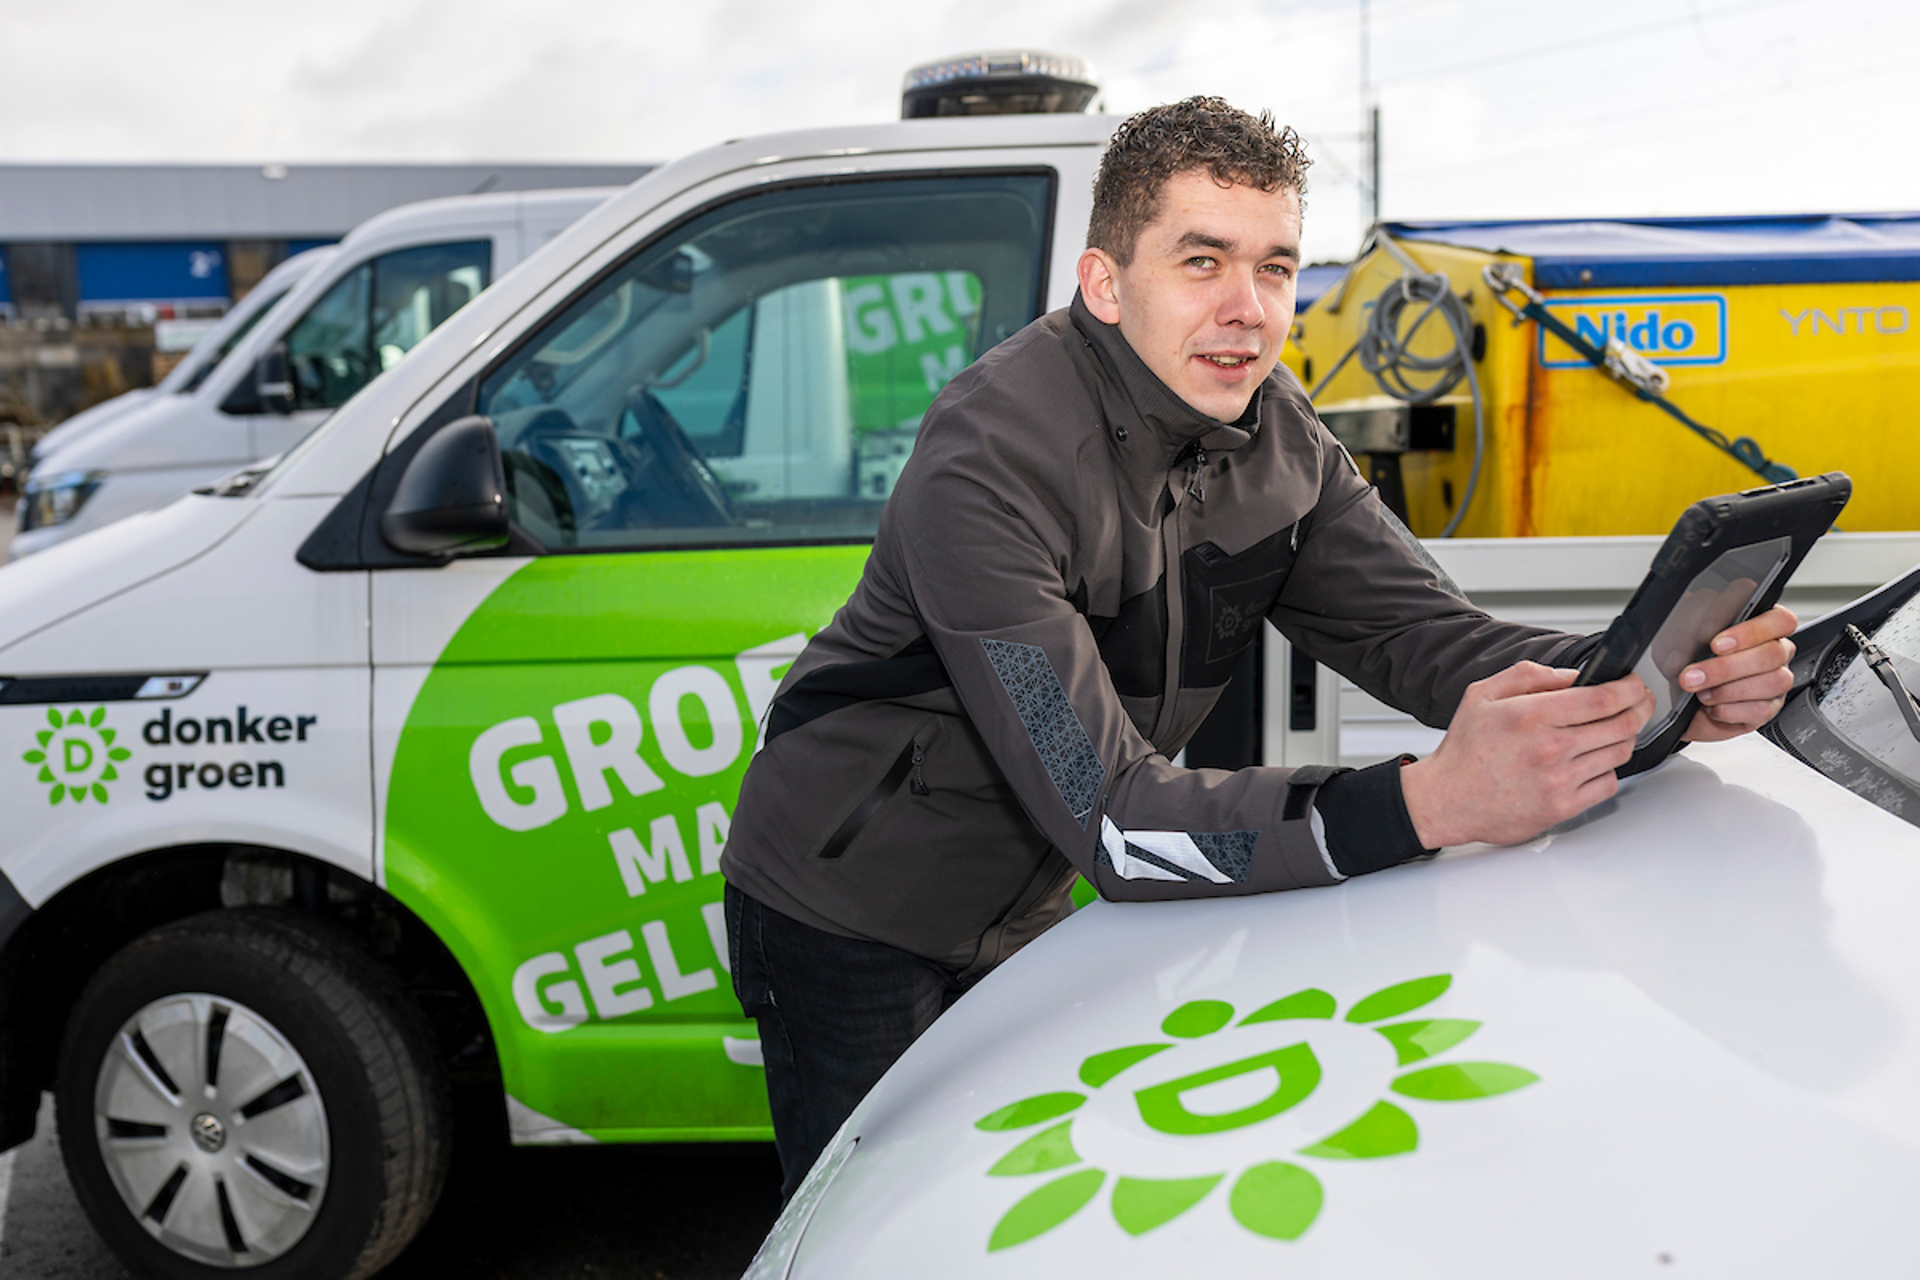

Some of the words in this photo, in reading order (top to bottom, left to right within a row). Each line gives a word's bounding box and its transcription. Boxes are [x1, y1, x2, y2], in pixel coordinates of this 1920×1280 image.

[1574, 309, 1697, 352] Nido
[1779, 305, 1909, 336] YNTO
[142, 706, 317, 745] donker
[63, 738, 94, 773] D
[144, 760, 285, 802] groen
[512, 902, 731, 1033] GEL
[1134, 1041, 1322, 1136] D
